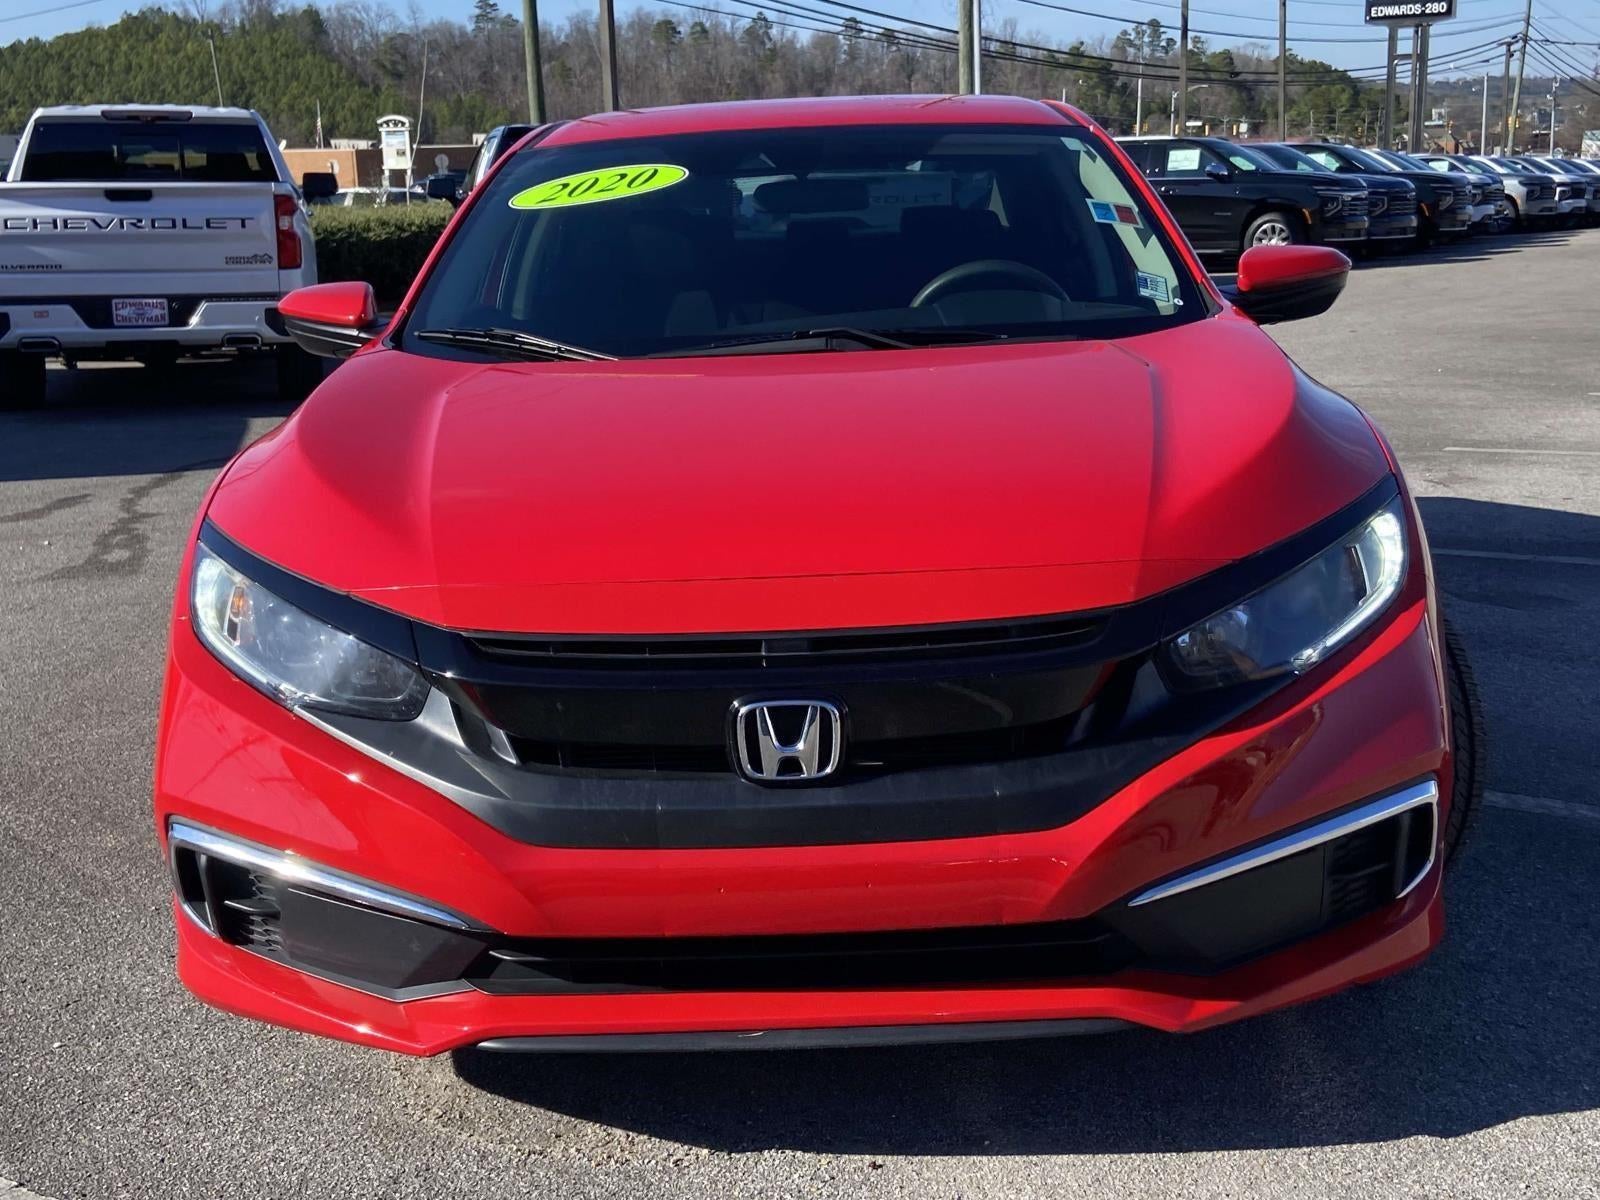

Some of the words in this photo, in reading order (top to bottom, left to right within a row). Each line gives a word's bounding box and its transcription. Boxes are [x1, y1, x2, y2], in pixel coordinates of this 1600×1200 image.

[1370, 2, 1447, 17] EDWARDS-280
[536, 168, 659, 205] 2020
[3, 217, 256, 231] CHEVROLET
